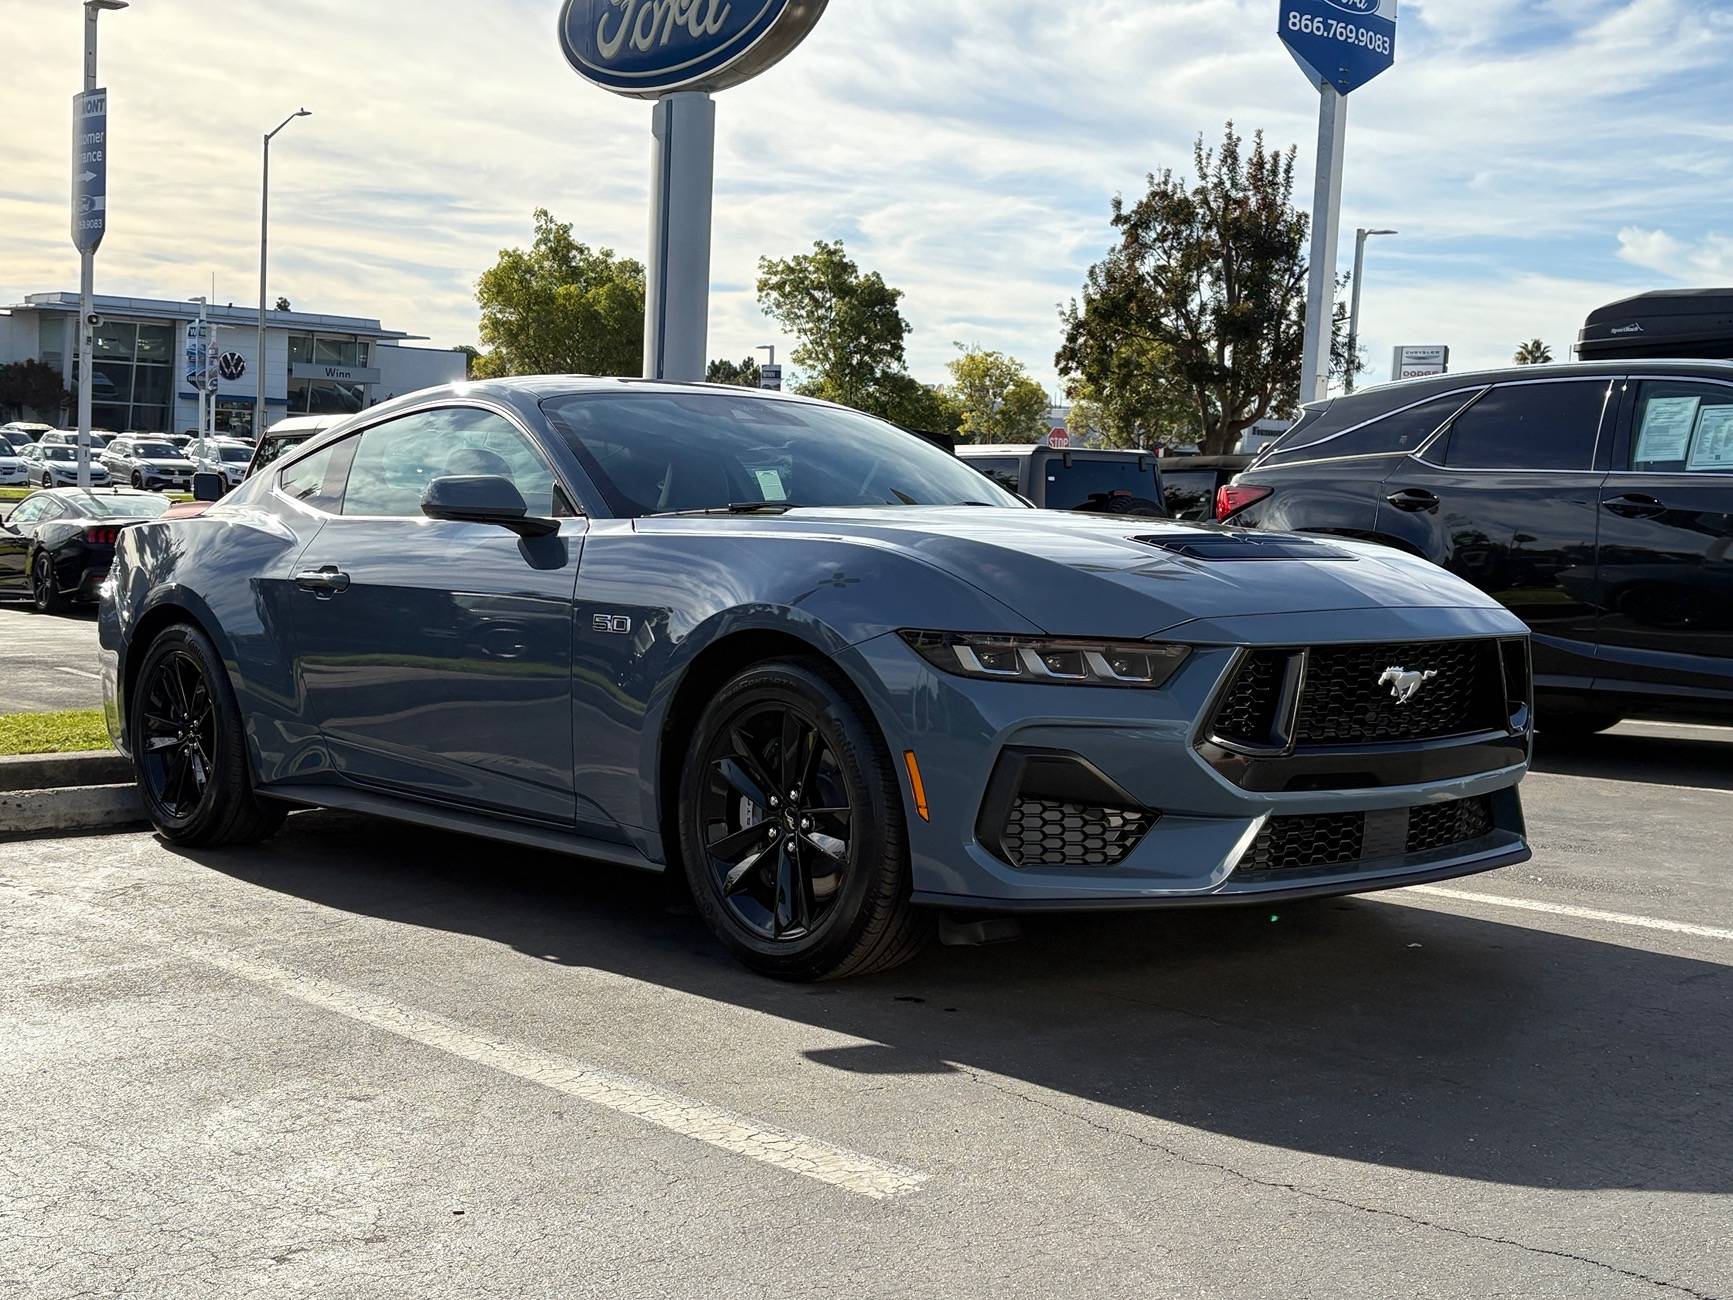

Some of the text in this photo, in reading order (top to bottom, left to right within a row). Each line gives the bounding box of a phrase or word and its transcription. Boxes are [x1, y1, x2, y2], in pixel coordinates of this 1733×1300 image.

[1288, 11, 1390, 55] 866.769.9083
[325, 367, 351, 378] Winn
[1050, 437, 1069, 448] STOP
[593, 614, 631, 634] 5.0
